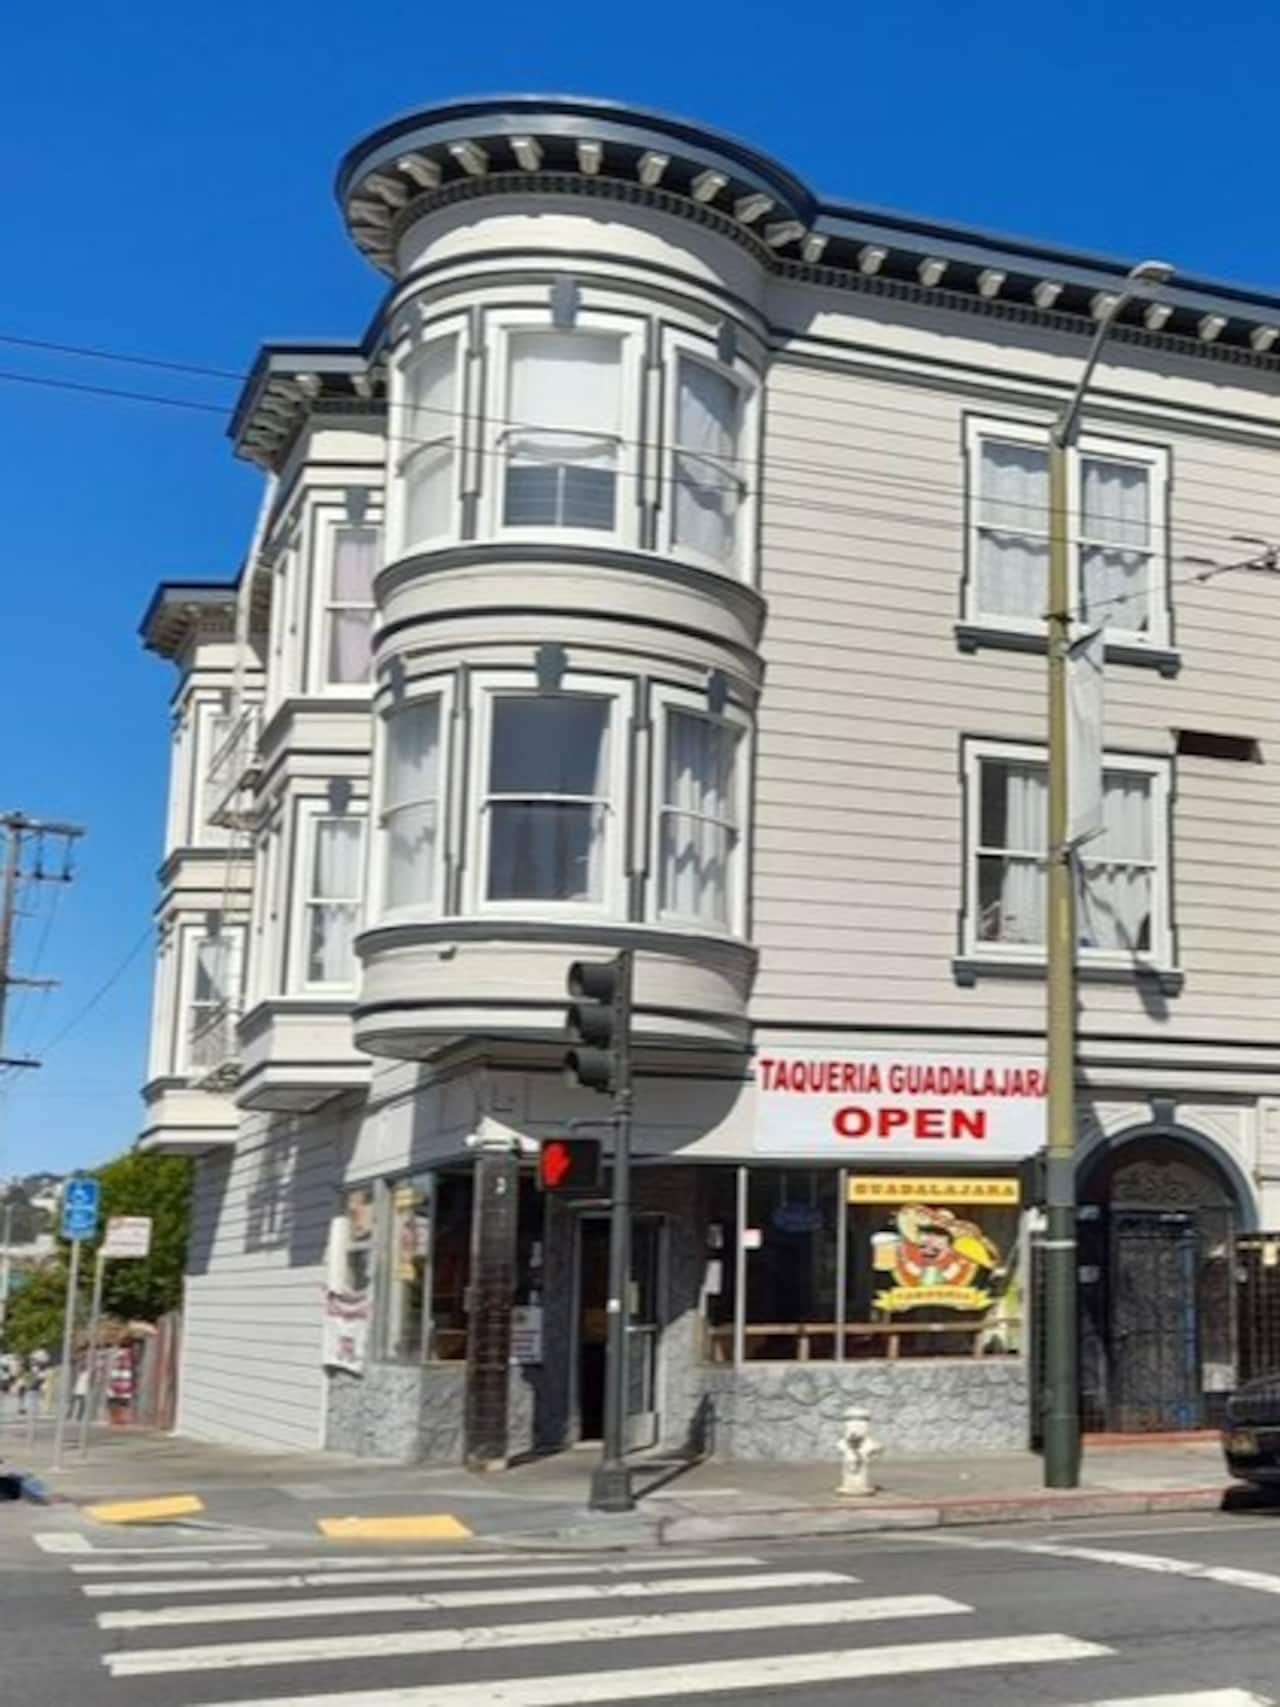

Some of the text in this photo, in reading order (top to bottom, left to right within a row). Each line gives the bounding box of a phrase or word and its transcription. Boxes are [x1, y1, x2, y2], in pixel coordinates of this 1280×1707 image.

[759, 1060, 882, 1093] TAQUERIA
[833, 1106, 986, 1139] OPEN
[854, 1183, 1015, 1195] GUADALAJARA
